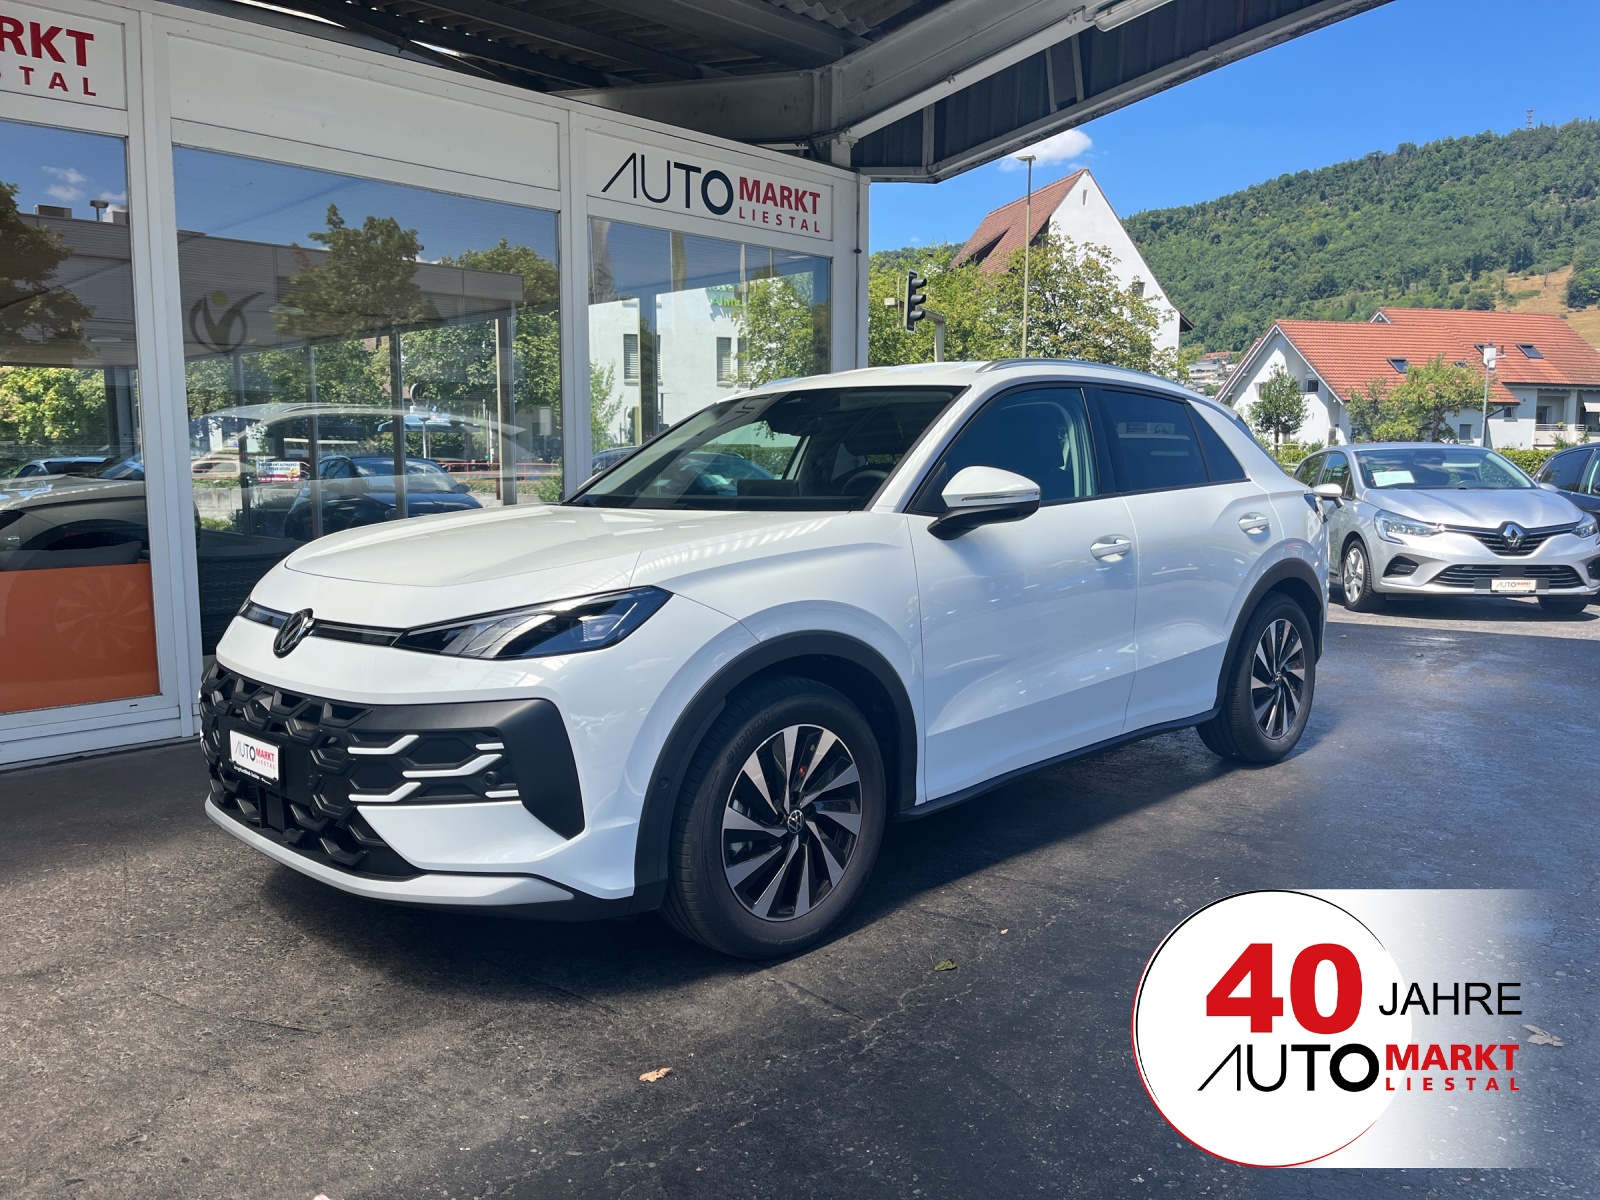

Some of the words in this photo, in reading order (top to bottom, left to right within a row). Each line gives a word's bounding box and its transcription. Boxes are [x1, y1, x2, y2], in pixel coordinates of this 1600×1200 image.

[0, 65, 97, 97] TAL
[601, 152, 734, 216] AUTO
[739, 176, 820, 215] MARKT
[739, 206, 820, 233] LIESTAL
[235, 740, 256, 762] AUTO
[255, 747, 275, 762] MARKT
